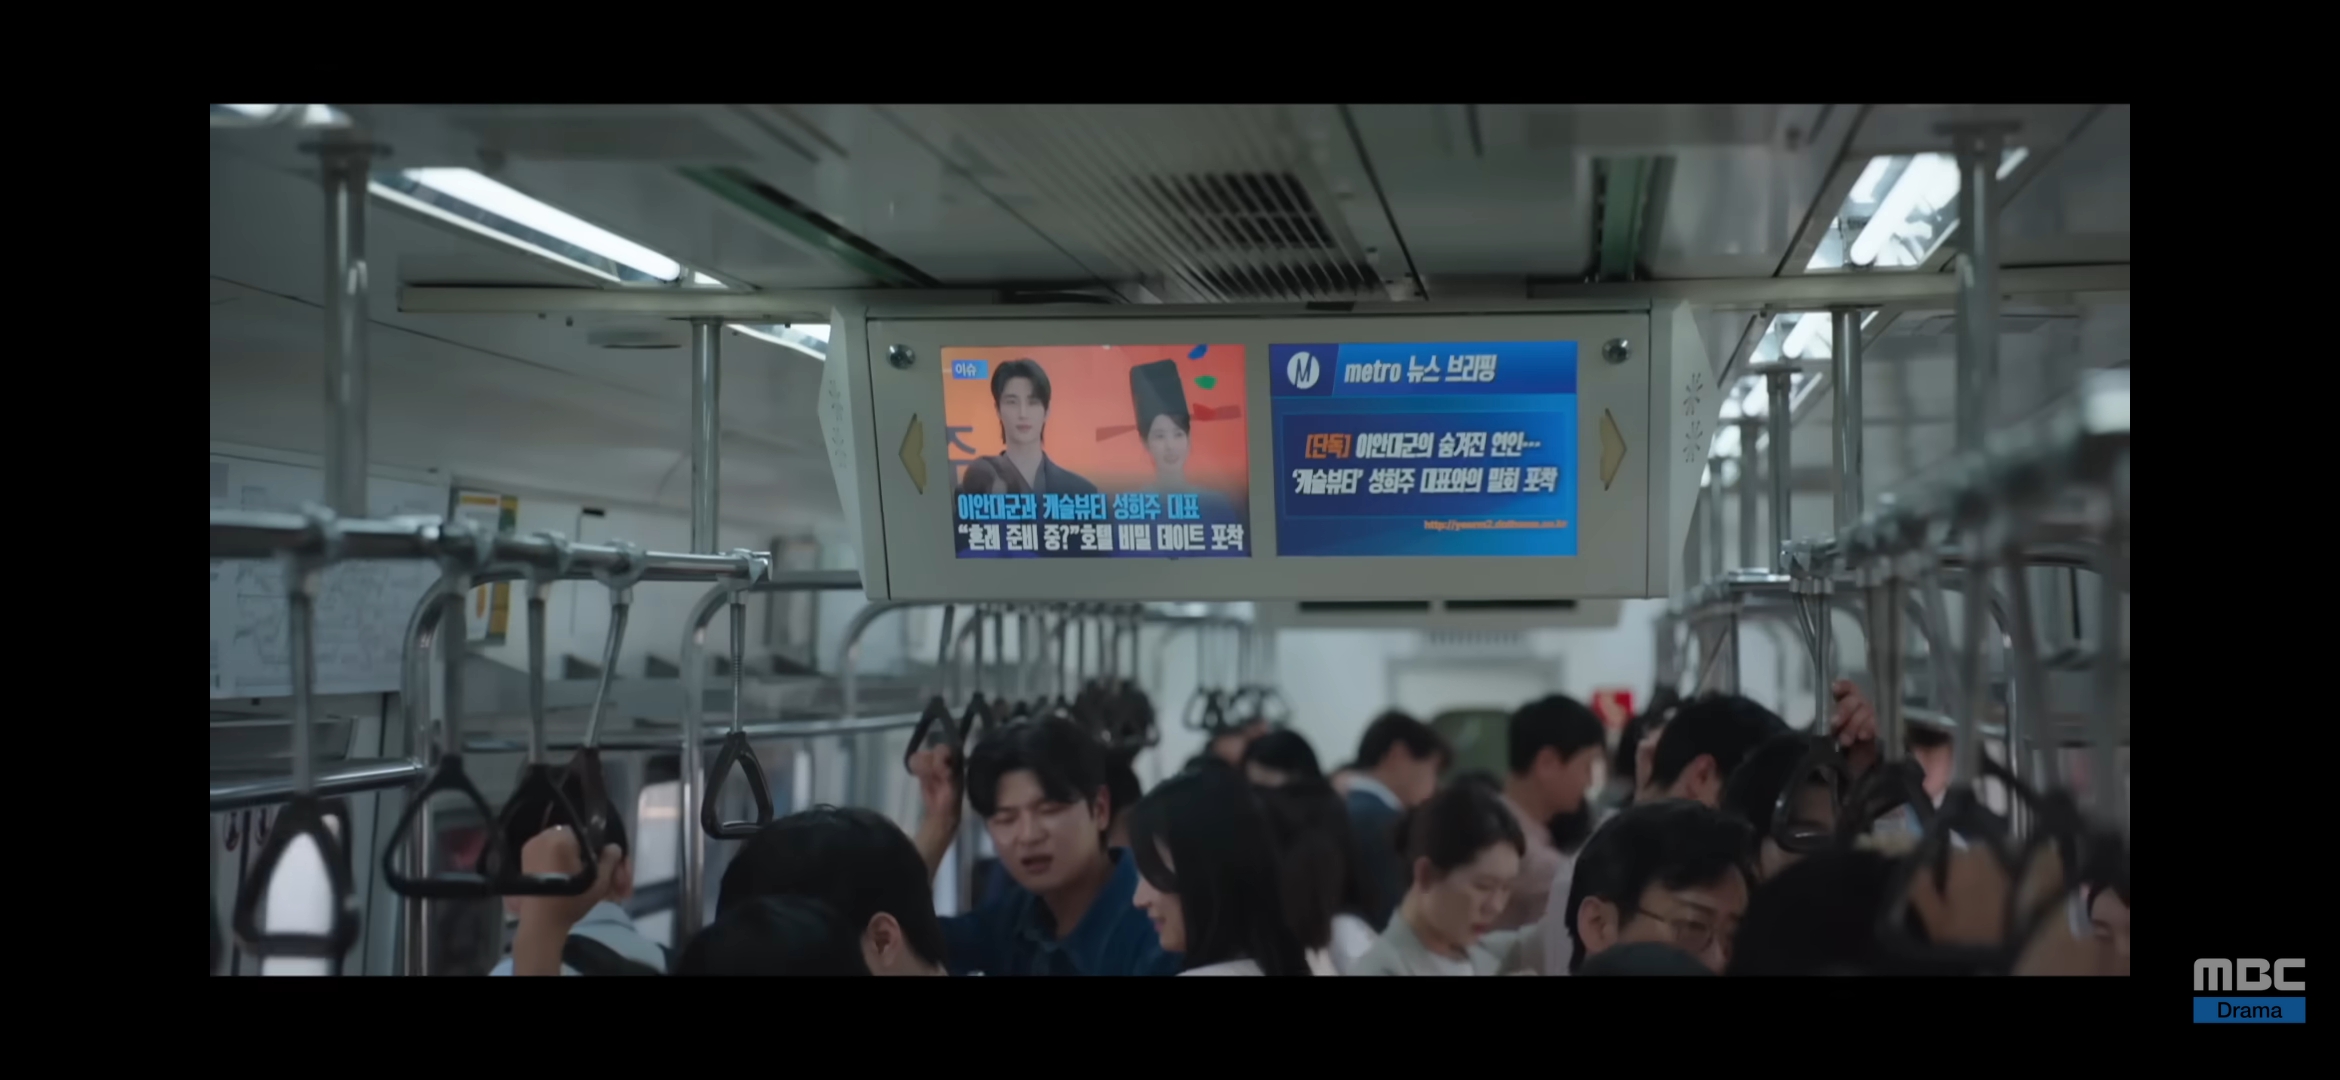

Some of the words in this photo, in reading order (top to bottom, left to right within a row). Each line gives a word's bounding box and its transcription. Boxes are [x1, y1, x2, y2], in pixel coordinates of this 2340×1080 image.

[955, 363, 977, 377] 이슈
[1344, 360, 1402, 383] metro
[1407, 355, 1441, 383] 뉴스
[1445, 354, 1497, 382] 브리핑
[1305, 433, 1352, 459] [단독]
[1355, 432, 1434, 459] 이안대군의
[1438, 432, 1487, 458] 숨겨진
[1368, 468, 1416, 494] 성희주
[1420, 467, 1483, 493] 대표와의
[1487, 467, 1520, 493] 밀회
[1523, 467, 1558, 493] 포착
[957, 493, 1037, 520] 이안대군과
[1043, 493, 1107, 520] 캐슬뷰티
[1113, 493, 1161, 520] 성희주
[1167, 493, 1200, 519] 대표
[1006, 523, 1039, 551] 준비
[1118, 523, 1152, 551] 비밀
[1157, 523, 1206, 551] 데이트
[1211, 523, 1244, 551] 포착
